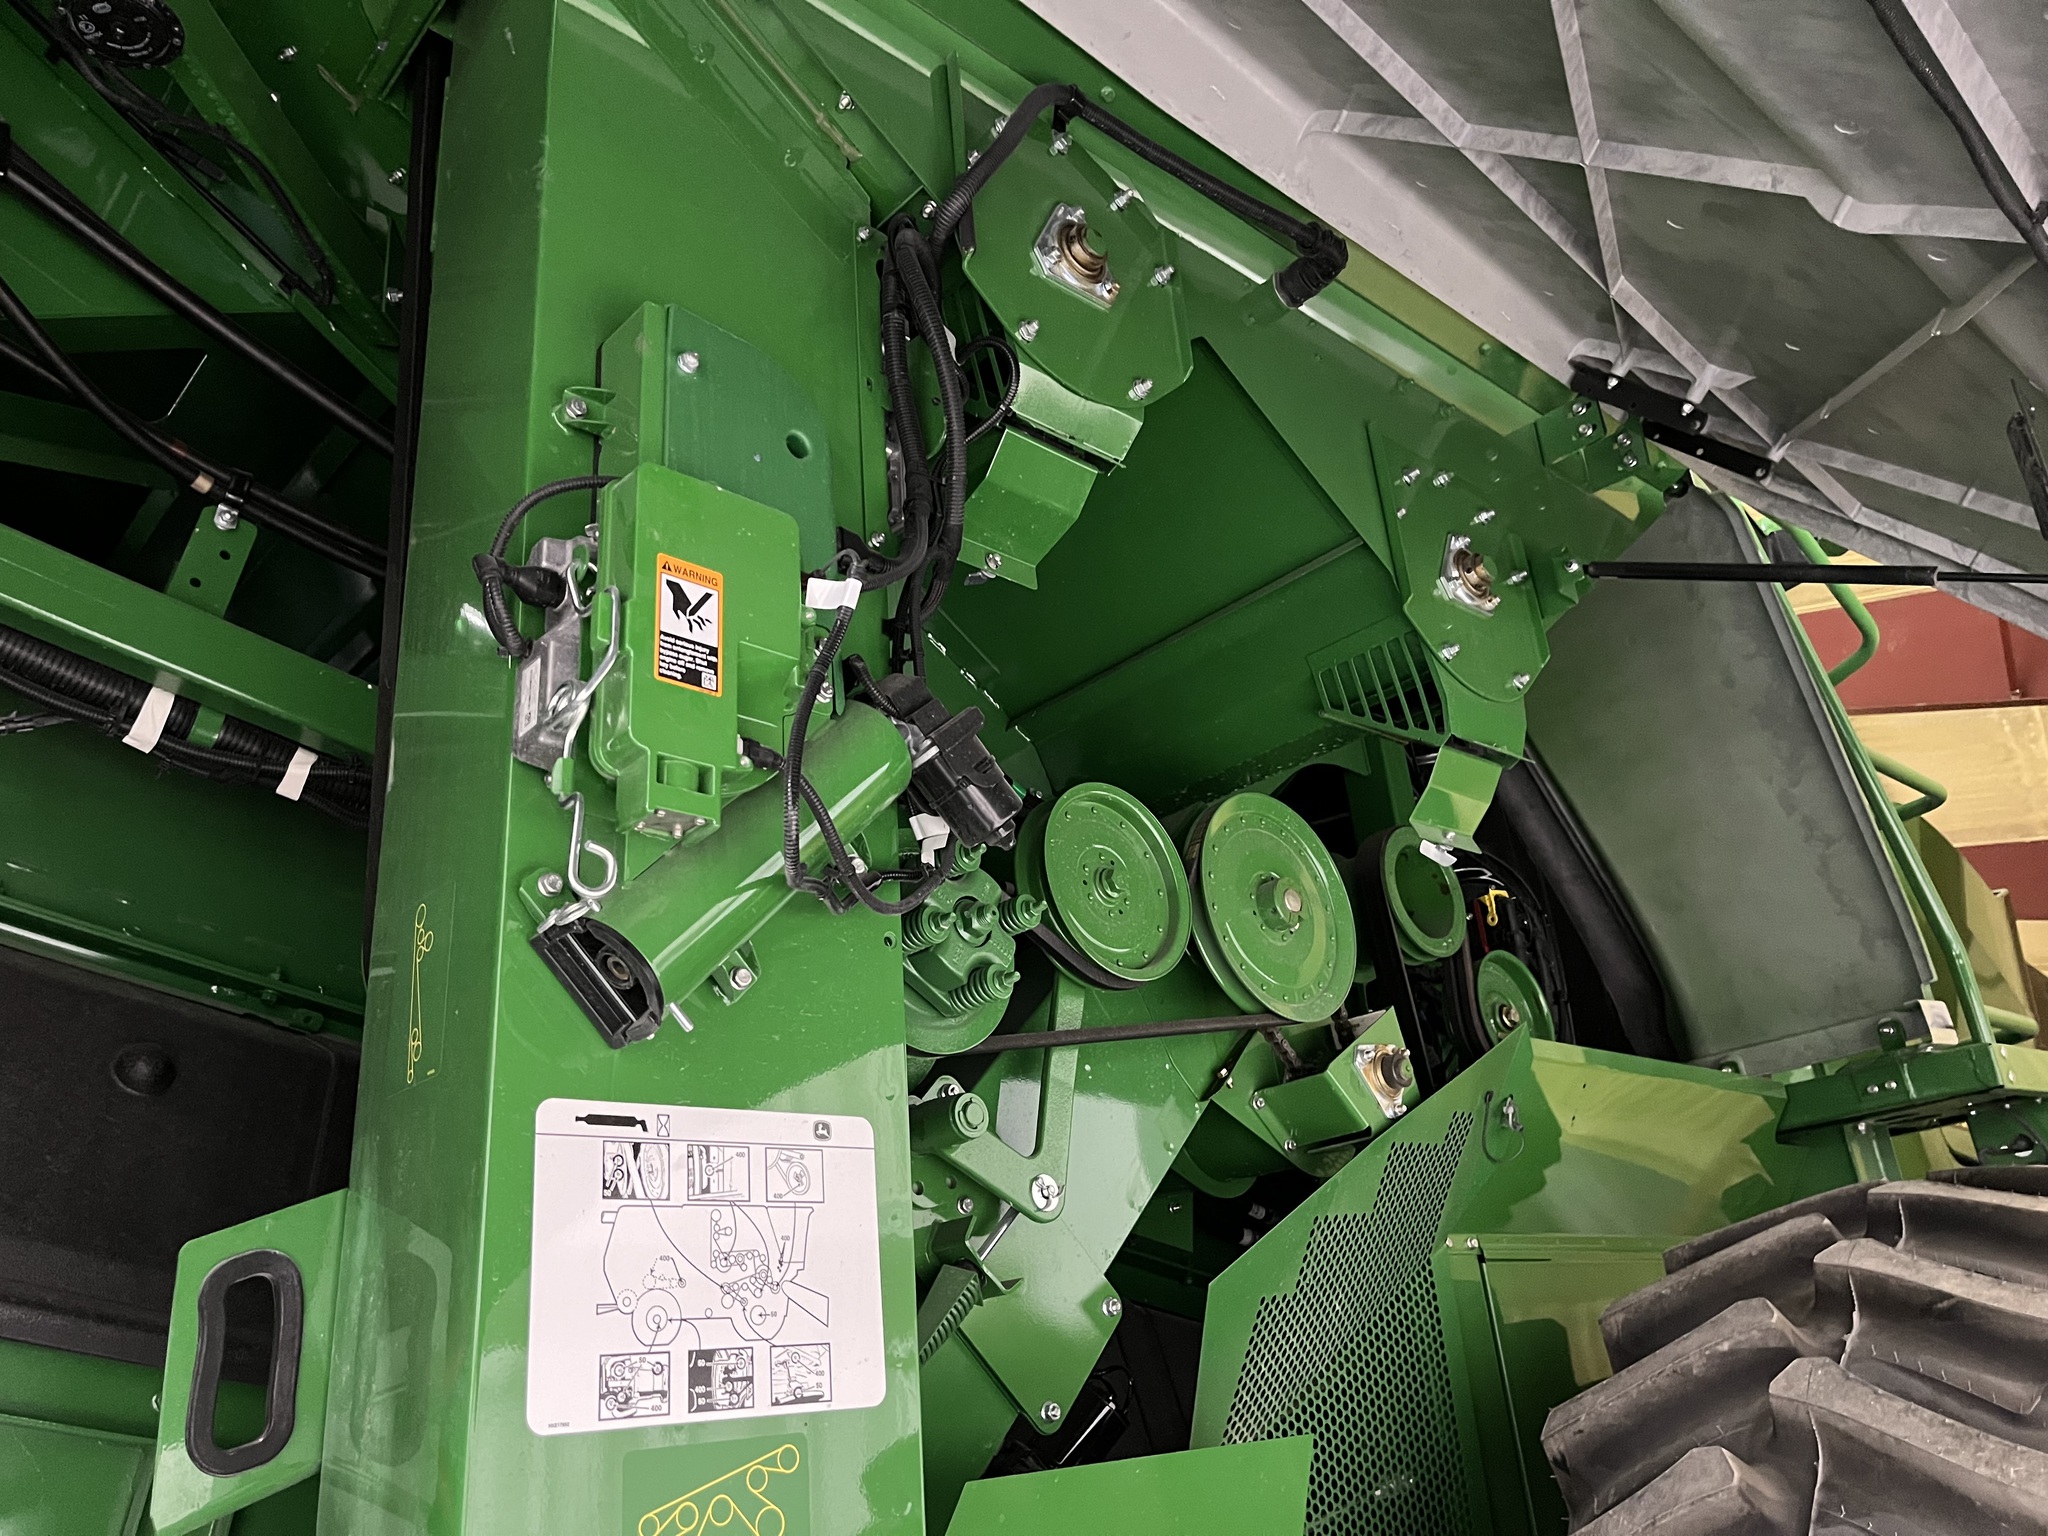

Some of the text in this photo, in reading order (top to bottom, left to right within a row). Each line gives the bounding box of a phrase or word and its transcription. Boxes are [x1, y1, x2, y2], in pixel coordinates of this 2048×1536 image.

[673, 564, 718, 587] WARNING
[603, 1188, 612, 1197] 50
[773, 1192, 783, 1200] 400
[638, 1356, 647, 1364] 50
[695, 1385, 706, 1393] 400
[651, 1404, 662, 1412] 400
